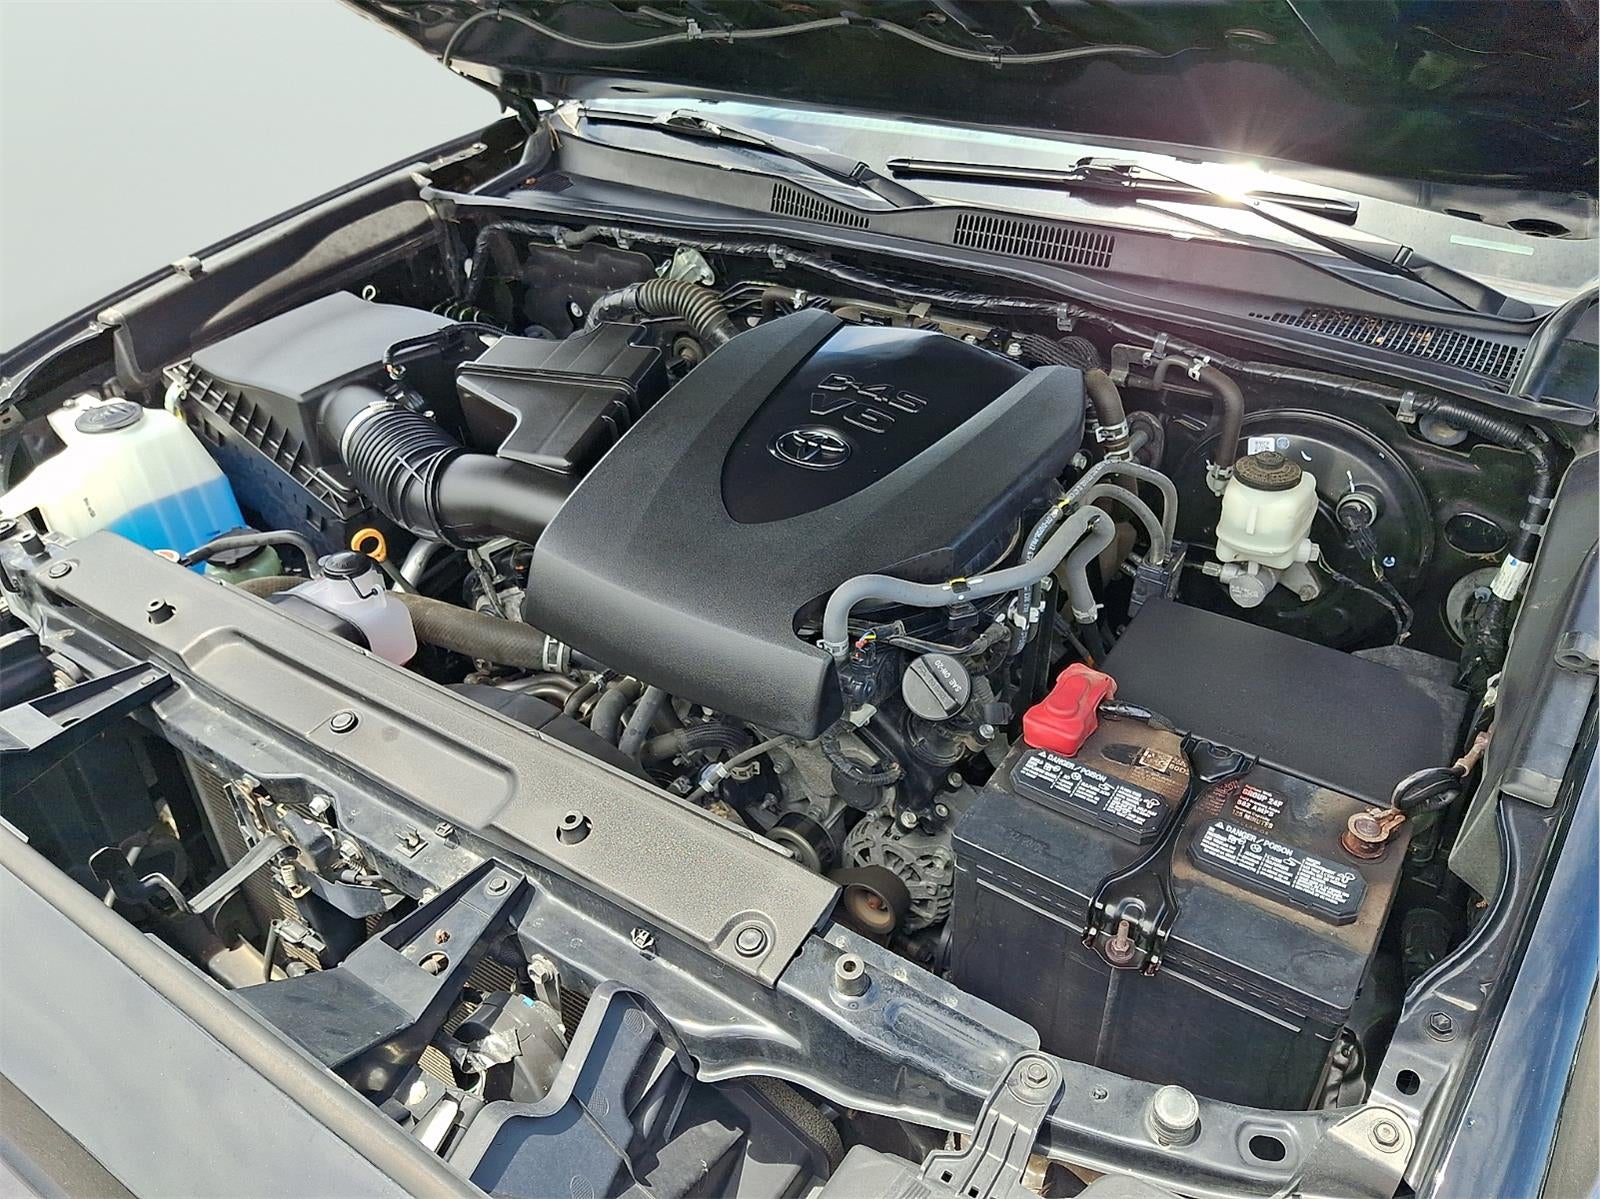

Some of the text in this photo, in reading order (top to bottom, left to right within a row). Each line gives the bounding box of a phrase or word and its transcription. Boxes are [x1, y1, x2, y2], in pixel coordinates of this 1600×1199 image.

[810, 392, 896, 433] V6
[948, 678, 962, 693] SAE
[1047, 753, 1075, 770] DANGER
[1080, 767, 1107, 782] POISON
[1241, 787, 1268, 802] GROUP
[1251, 804, 1275, 817] AMPS
[1225, 824, 1257, 843] DANGER
[1262, 839, 1294, 857] POISON
